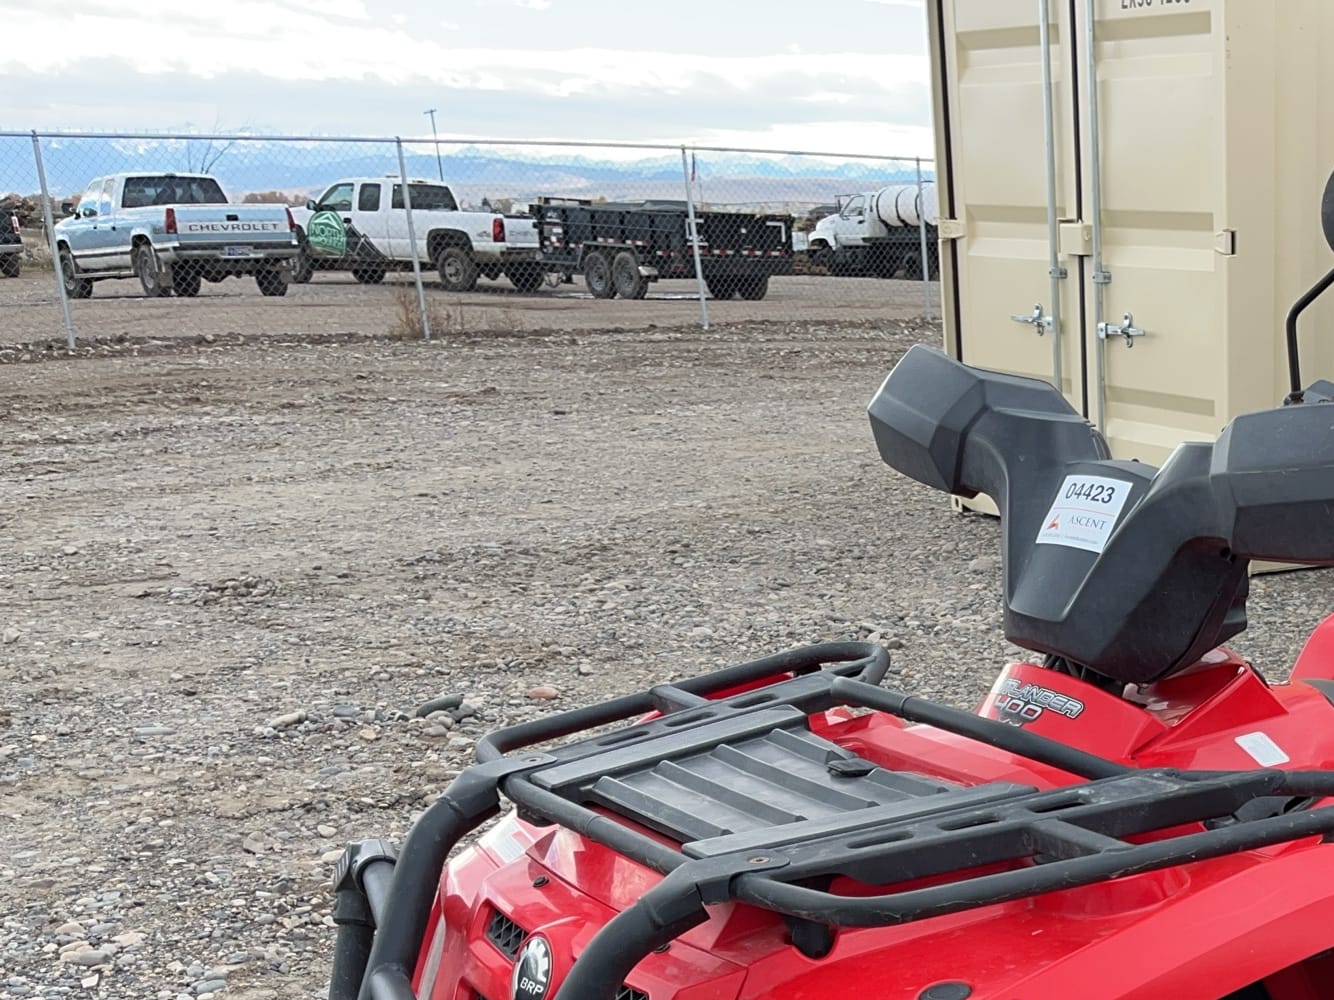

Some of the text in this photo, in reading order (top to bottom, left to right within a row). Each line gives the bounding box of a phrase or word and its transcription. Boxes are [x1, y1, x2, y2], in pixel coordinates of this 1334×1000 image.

[188, 222, 279, 232] CHEVROLET
[1065, 482, 1115, 504] 04423
[1070, 514, 1107, 530] ASCENT
[995, 695, 1043, 719] 400
[520, 976, 544, 995] BRP
